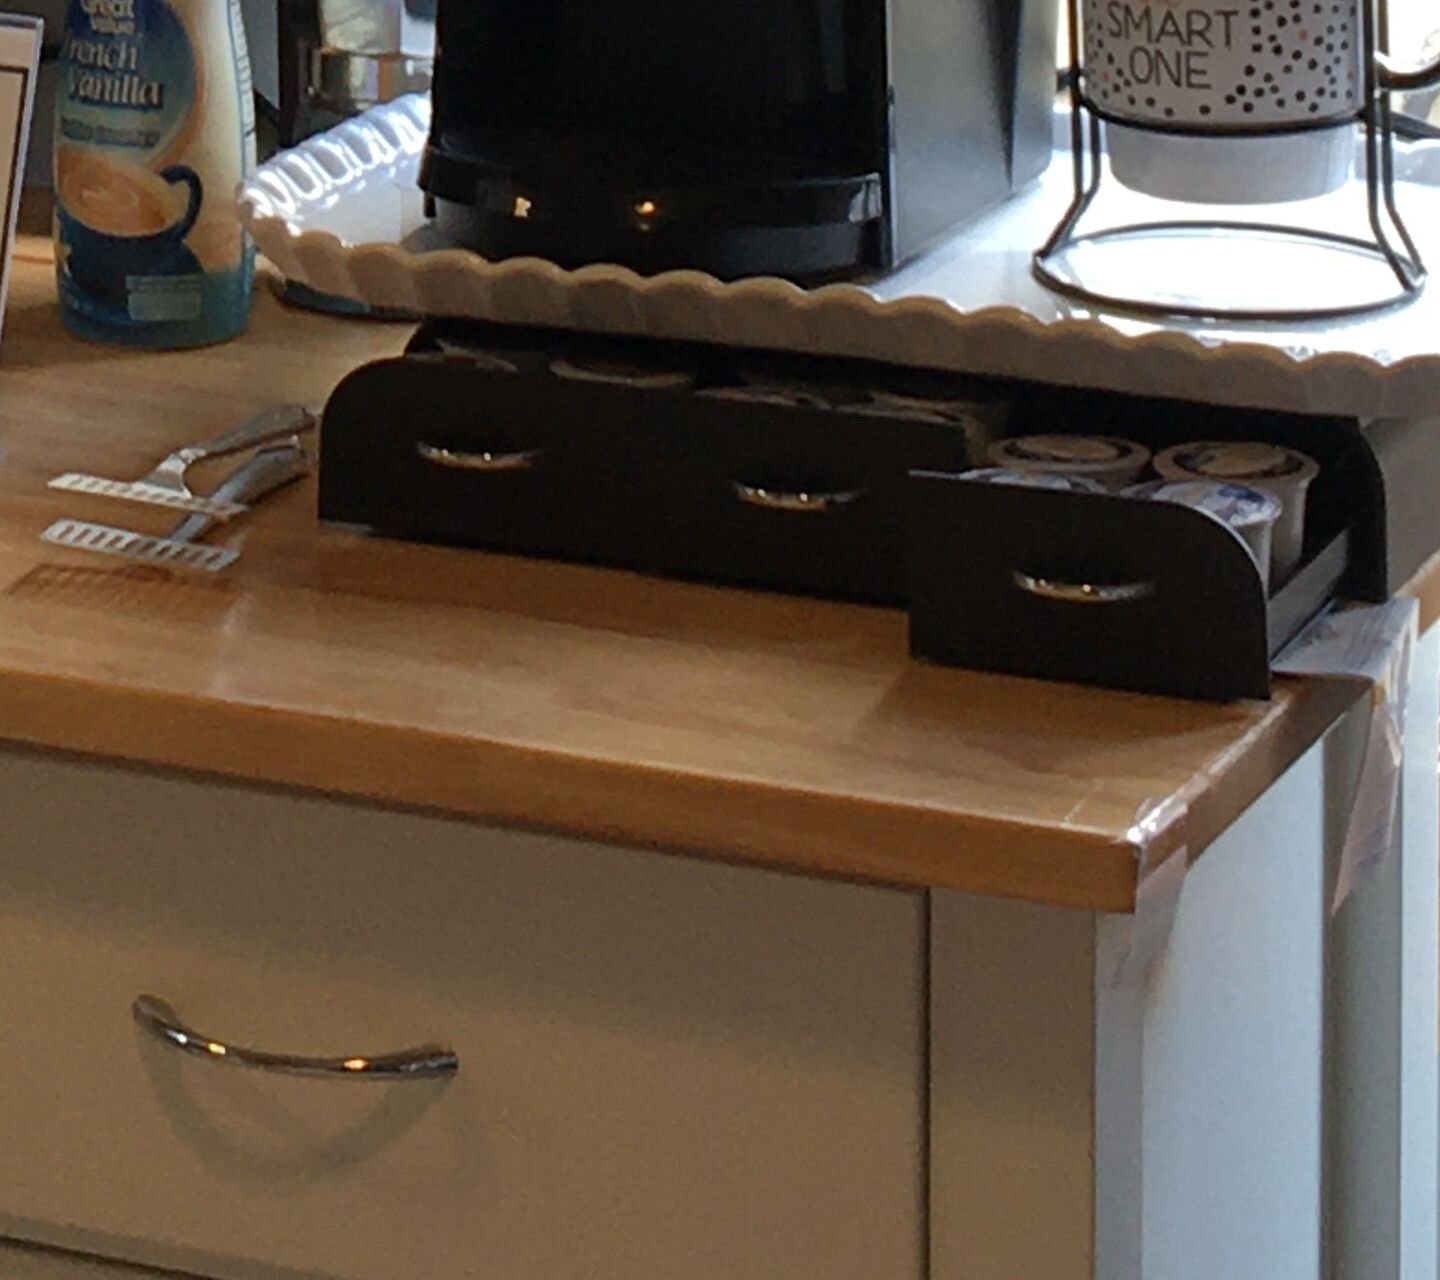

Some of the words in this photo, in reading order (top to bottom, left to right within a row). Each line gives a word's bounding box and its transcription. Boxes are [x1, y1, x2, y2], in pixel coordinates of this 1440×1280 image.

[1107, 1, 1239, 49] SMART
[68, 39, 138, 70] rench
[1128, 47, 1213, 90] ONE
